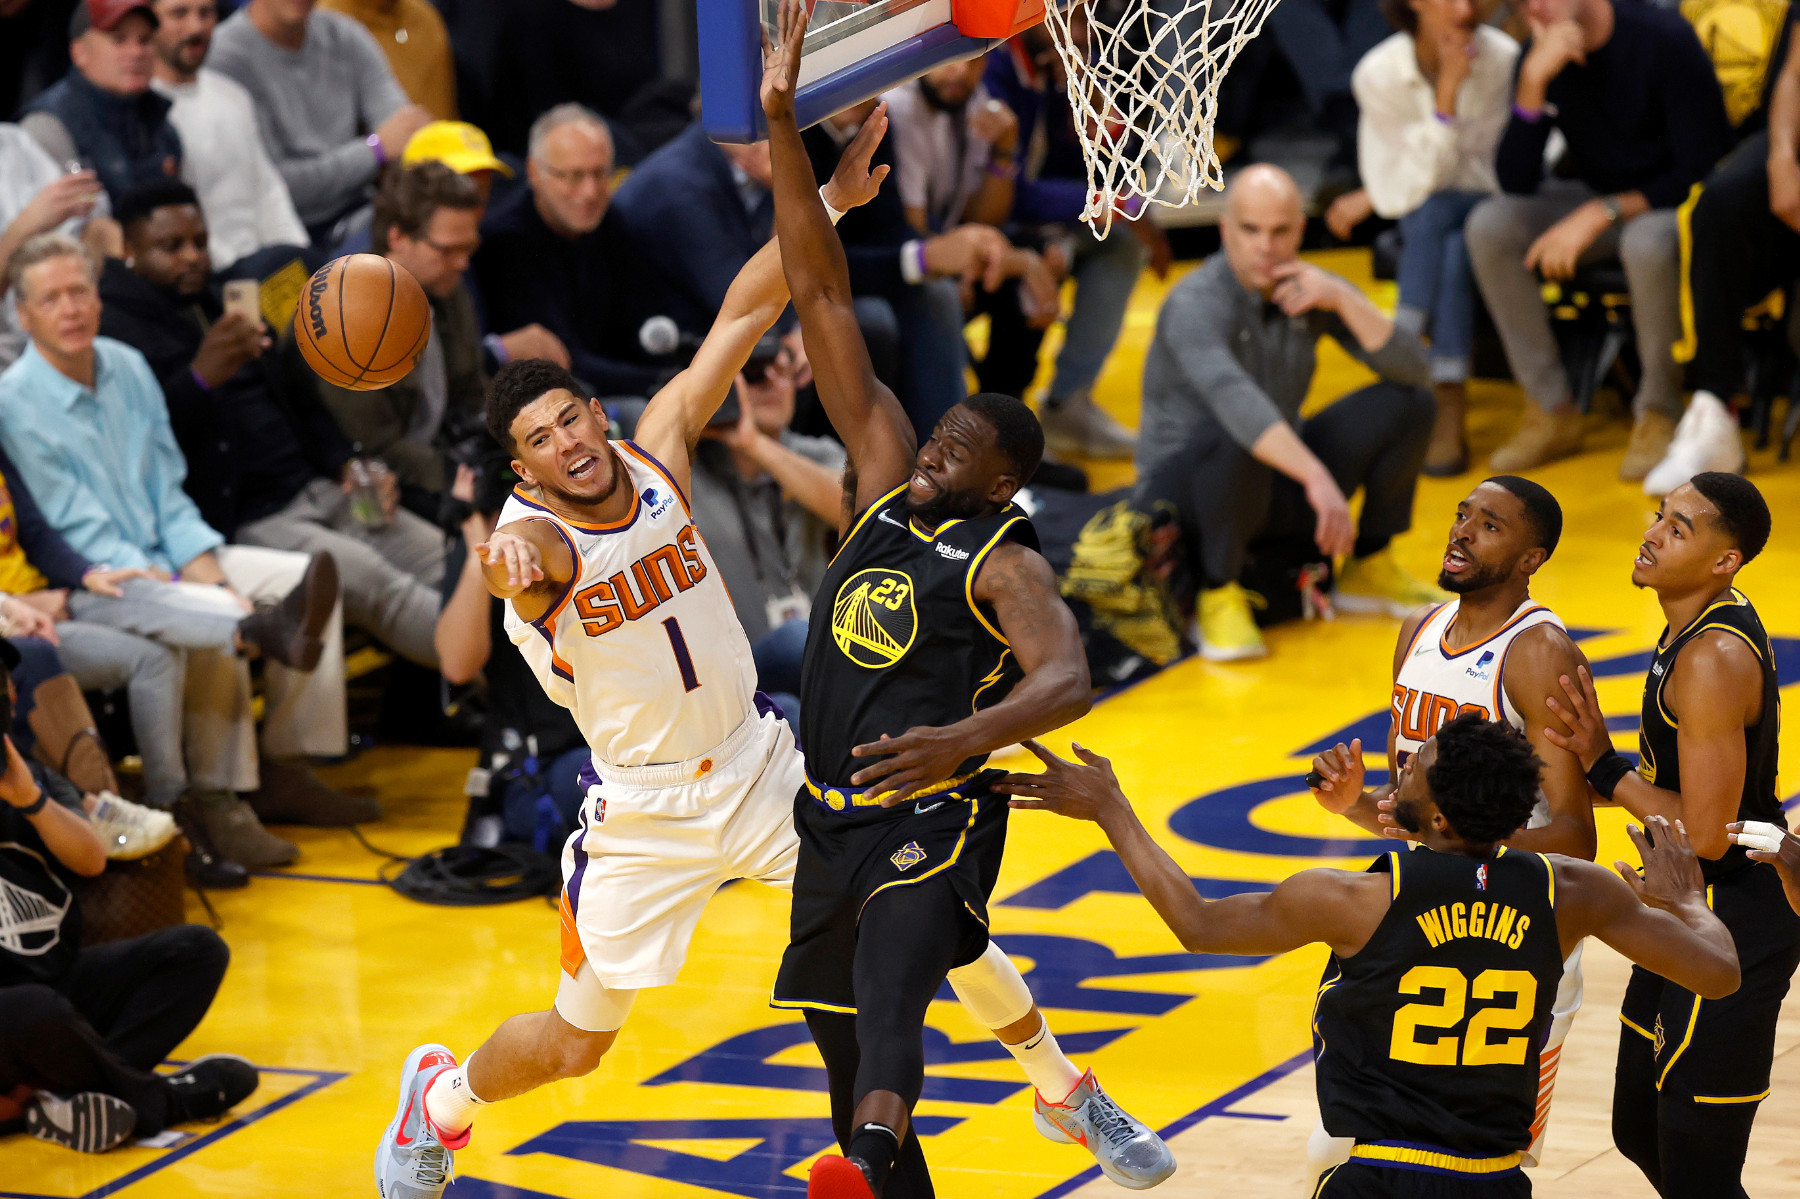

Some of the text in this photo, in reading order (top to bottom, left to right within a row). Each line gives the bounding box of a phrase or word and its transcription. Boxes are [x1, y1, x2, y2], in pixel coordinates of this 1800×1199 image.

[651, 495, 674, 519] PayPal
[935, 541, 969, 560] Rakuten
[573, 525, 707, 637] SUNS
[868, 577, 910, 611] 23
[661, 615, 702, 693] 1
[1466, 667, 1490, 681] PayPal
[1416, 901, 1531, 950] WIGGINS
[1389, 965, 1538, 1066] 22
